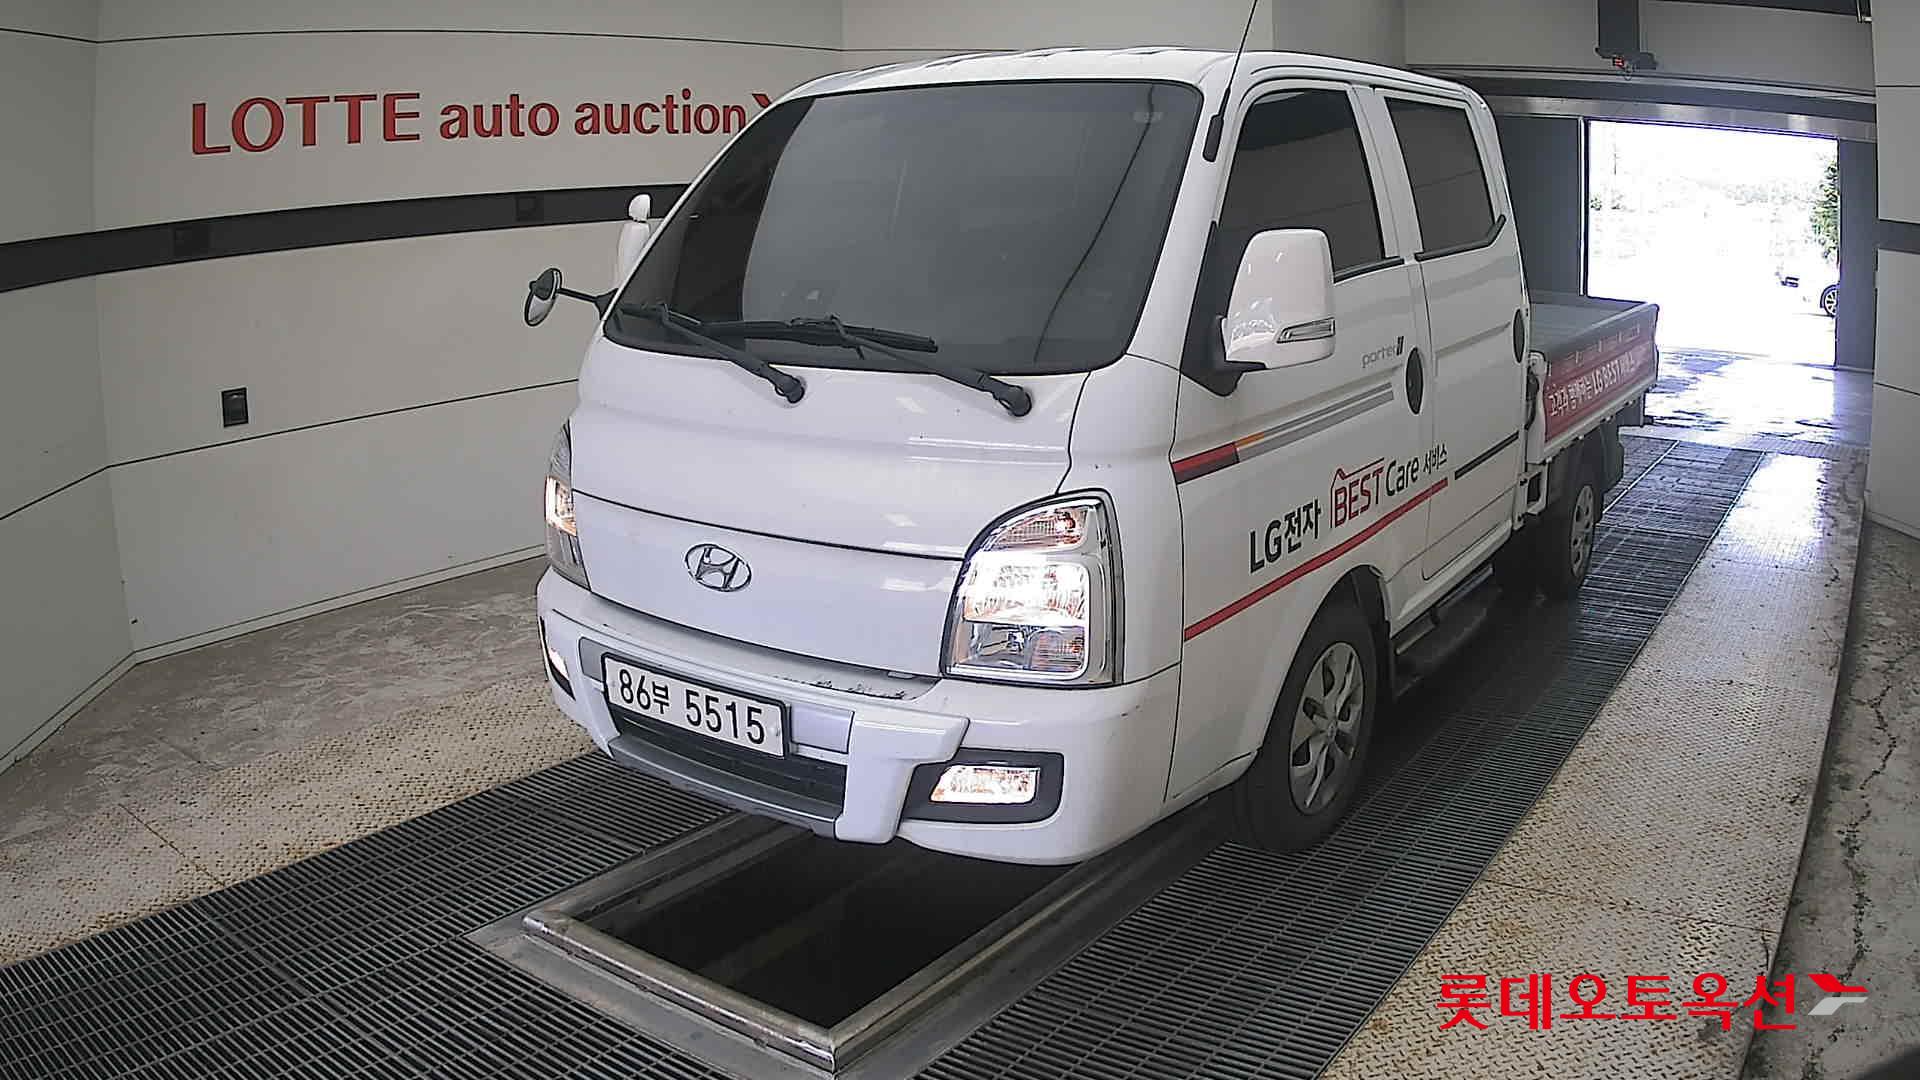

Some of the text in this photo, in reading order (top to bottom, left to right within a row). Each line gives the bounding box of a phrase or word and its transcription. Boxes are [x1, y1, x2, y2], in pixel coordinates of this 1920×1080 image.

[192, 88, 747, 155] LOTTE auto auction
[1591, 369, 1604, 395] LG
[1602, 358, 1621, 389] BEST
[1249, 443, 1448, 574] LG전자 BEST Care 서비스
[618, 668, 766, 745] 86부 5515
